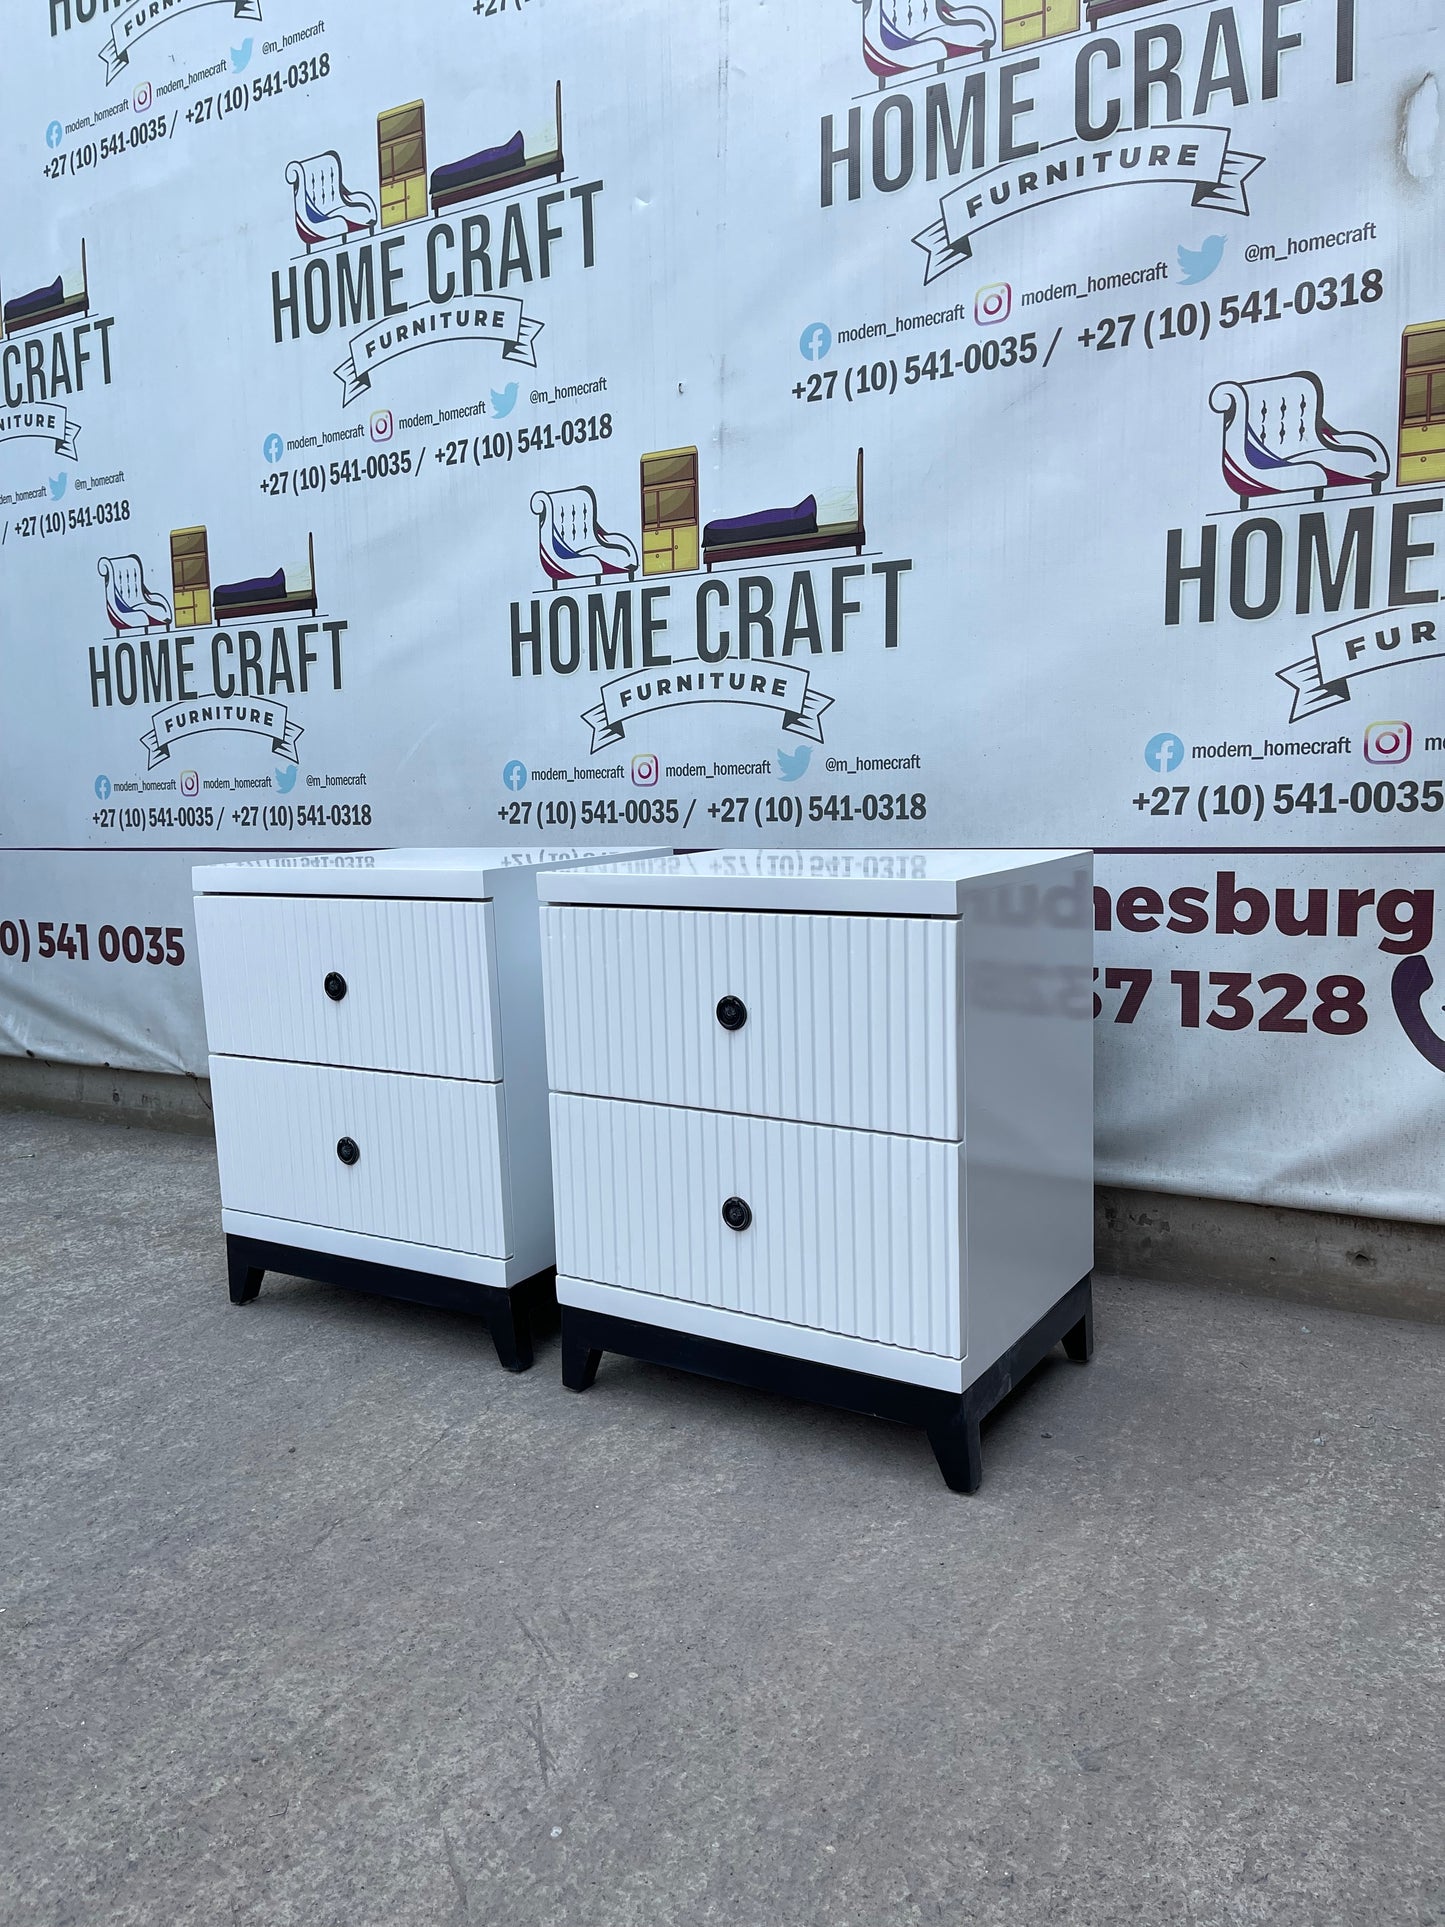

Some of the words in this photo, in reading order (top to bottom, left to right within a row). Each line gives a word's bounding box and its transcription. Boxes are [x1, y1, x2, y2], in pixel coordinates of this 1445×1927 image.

[124, 0, 181, 37] FURN
[262, 21, 325, 54] @m_homecraft
[101, 115, 166, 159] 541-0035
[169, 110, 178, 139] /
[253, 53, 330, 101] 541-0318
[821, 57, 1043, 208] HOME
[966, 145, 1199, 219] FURNITURE
[272, 235, 408, 343] HOME
[426, 180, 603, 304] CRAFT
[1245, 222, 1376, 262] @m_homecraft
[366, 311, 505, 358] FURNITURE
[904, 332, 1037, 384] 541-0035
[1042, 327, 1063, 367] /
[1219, 269, 1383, 328] 541-0318
[1, 317, 114, 408] CRAFT
[530, 377, 607, 404] @m_homecraft
[330, 450, 411, 485] 541-0035
[415, 447, 426, 477] /
[518, 413, 612, 453] 541-0318
[75, 471, 125, 491] @m_homecraft
[2, 521, 8, 543] /
[69, 500, 130, 529] 541-0318
[1165, 498, 1445, 625] HOME
[510, 586, 671, 677] HOME
[697, 559, 912, 663] CRAFT
[89, 636, 201, 707] HOME
[210, 620, 348, 699] CRAFT
[620, 673, 787, 708] FURNITURE
[165, 708, 273, 733] FURNITURE
[306, 773, 367, 788] @m_homecraft
[826, 754, 921, 774] @m_homecraft
[149, 807, 213, 827] 541-0035
[216, 807, 225, 831] /
[297, 804, 372, 826] 541-0318
[581, 799, 679, 824] 541-0035
[683, 799, 697, 829] /
[808, 793, 926, 821] 541-0318
[1273, 780, 1444, 814] 541-0035
[38, 922, 89, 960] 541
[98, 925, 185, 966] 0035
[1094, 967, 1152, 1024] 7
[1171, 970, 1368, 1035] 1328
